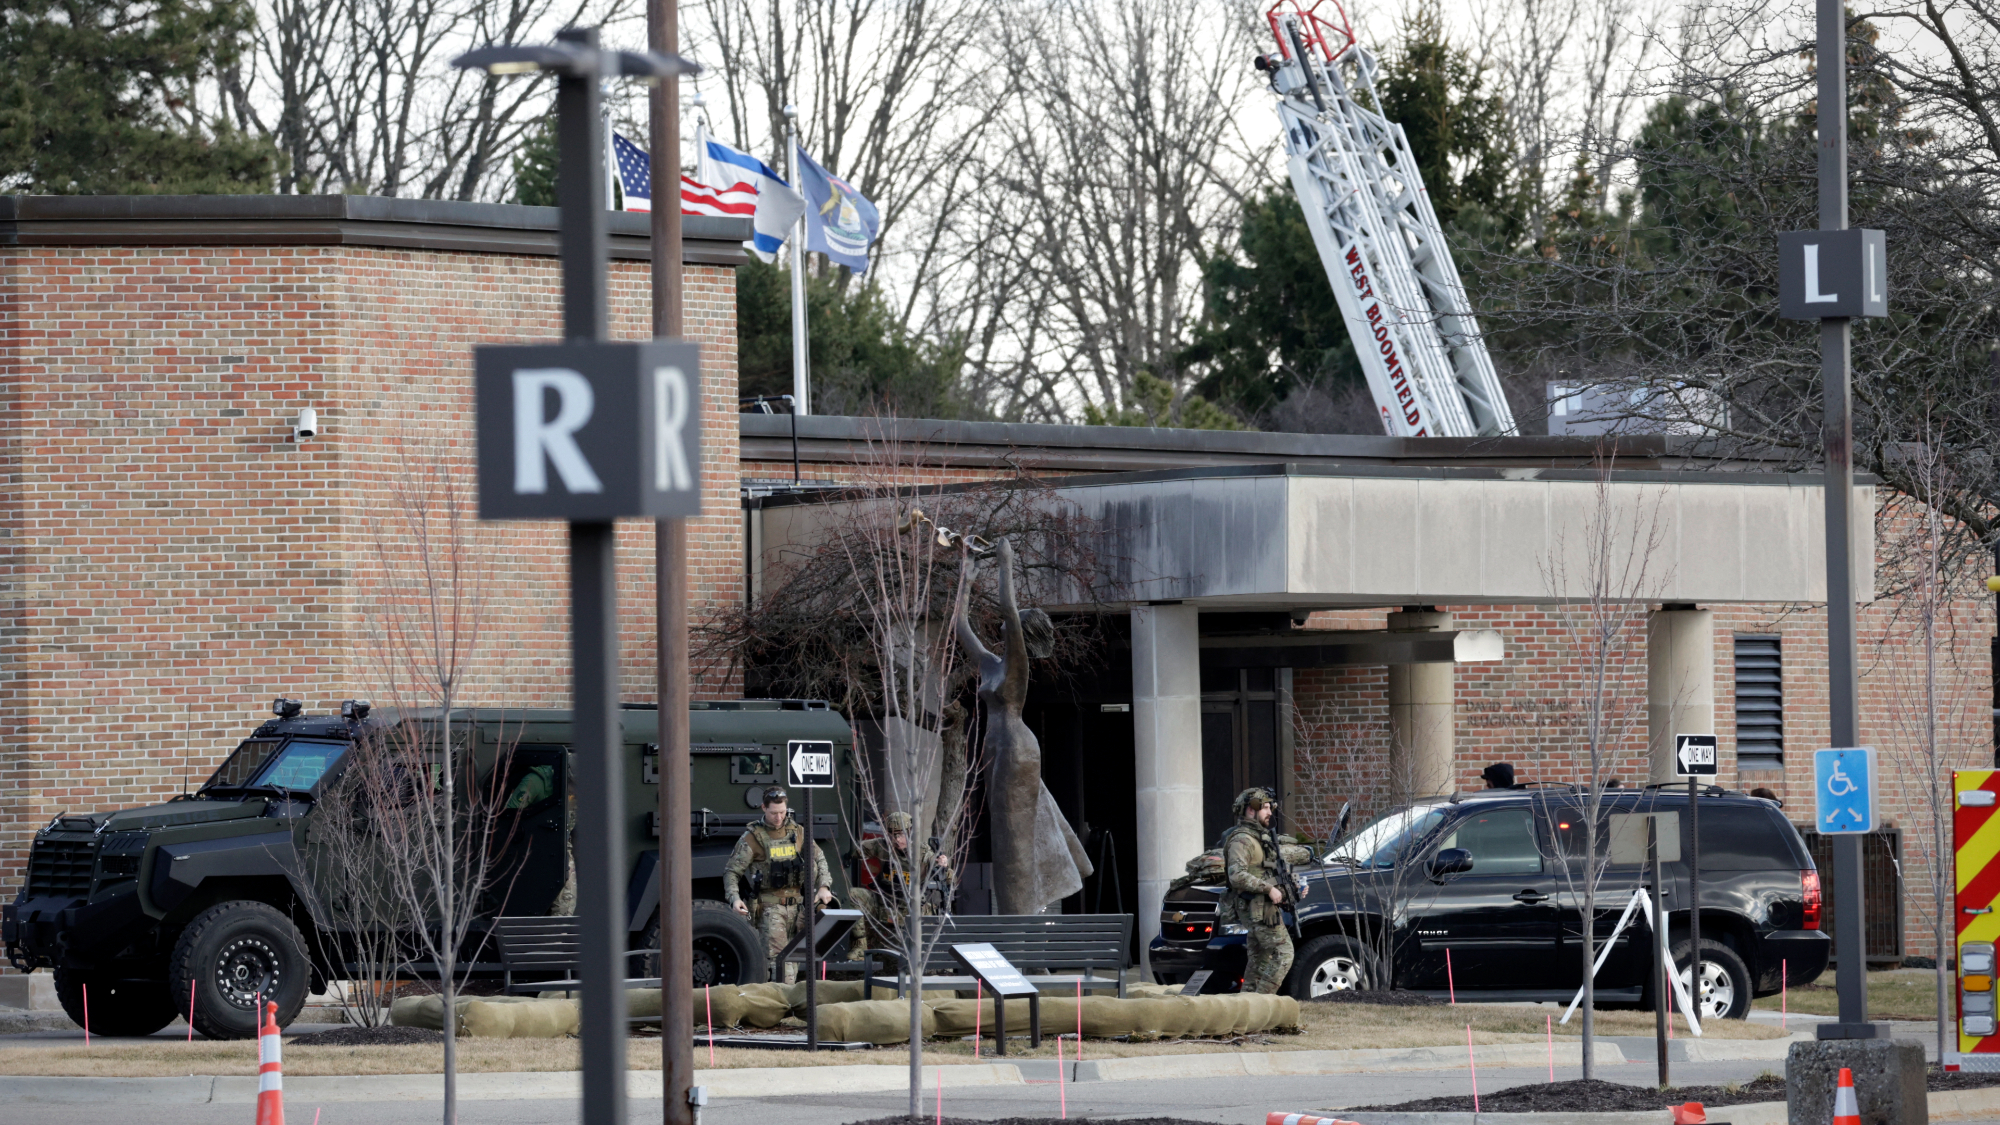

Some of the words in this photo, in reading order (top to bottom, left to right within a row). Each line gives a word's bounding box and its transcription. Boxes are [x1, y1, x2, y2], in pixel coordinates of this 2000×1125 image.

[1803, 243, 1838, 304] L
[1344, 244, 1374, 302] WEST
[1366, 302, 1421, 427] BLOOMFIELD
[512, 367, 604, 495] R
[653, 366, 693, 492] R
[1466, 701, 1501, 711] DAVID
[1512, 700, 1536, 711] AND
[1467, 715, 1527, 727] RELIGIOUS
[1536, 715, 1585, 727] SCHOOL
[802, 755, 814, 772] ONE
[815, 755, 829, 772] WAY
[1688, 747, 1699, 763] ONE
[1701, 747, 1713, 763] WAY
[143, 810, 221, 825] POLICE
